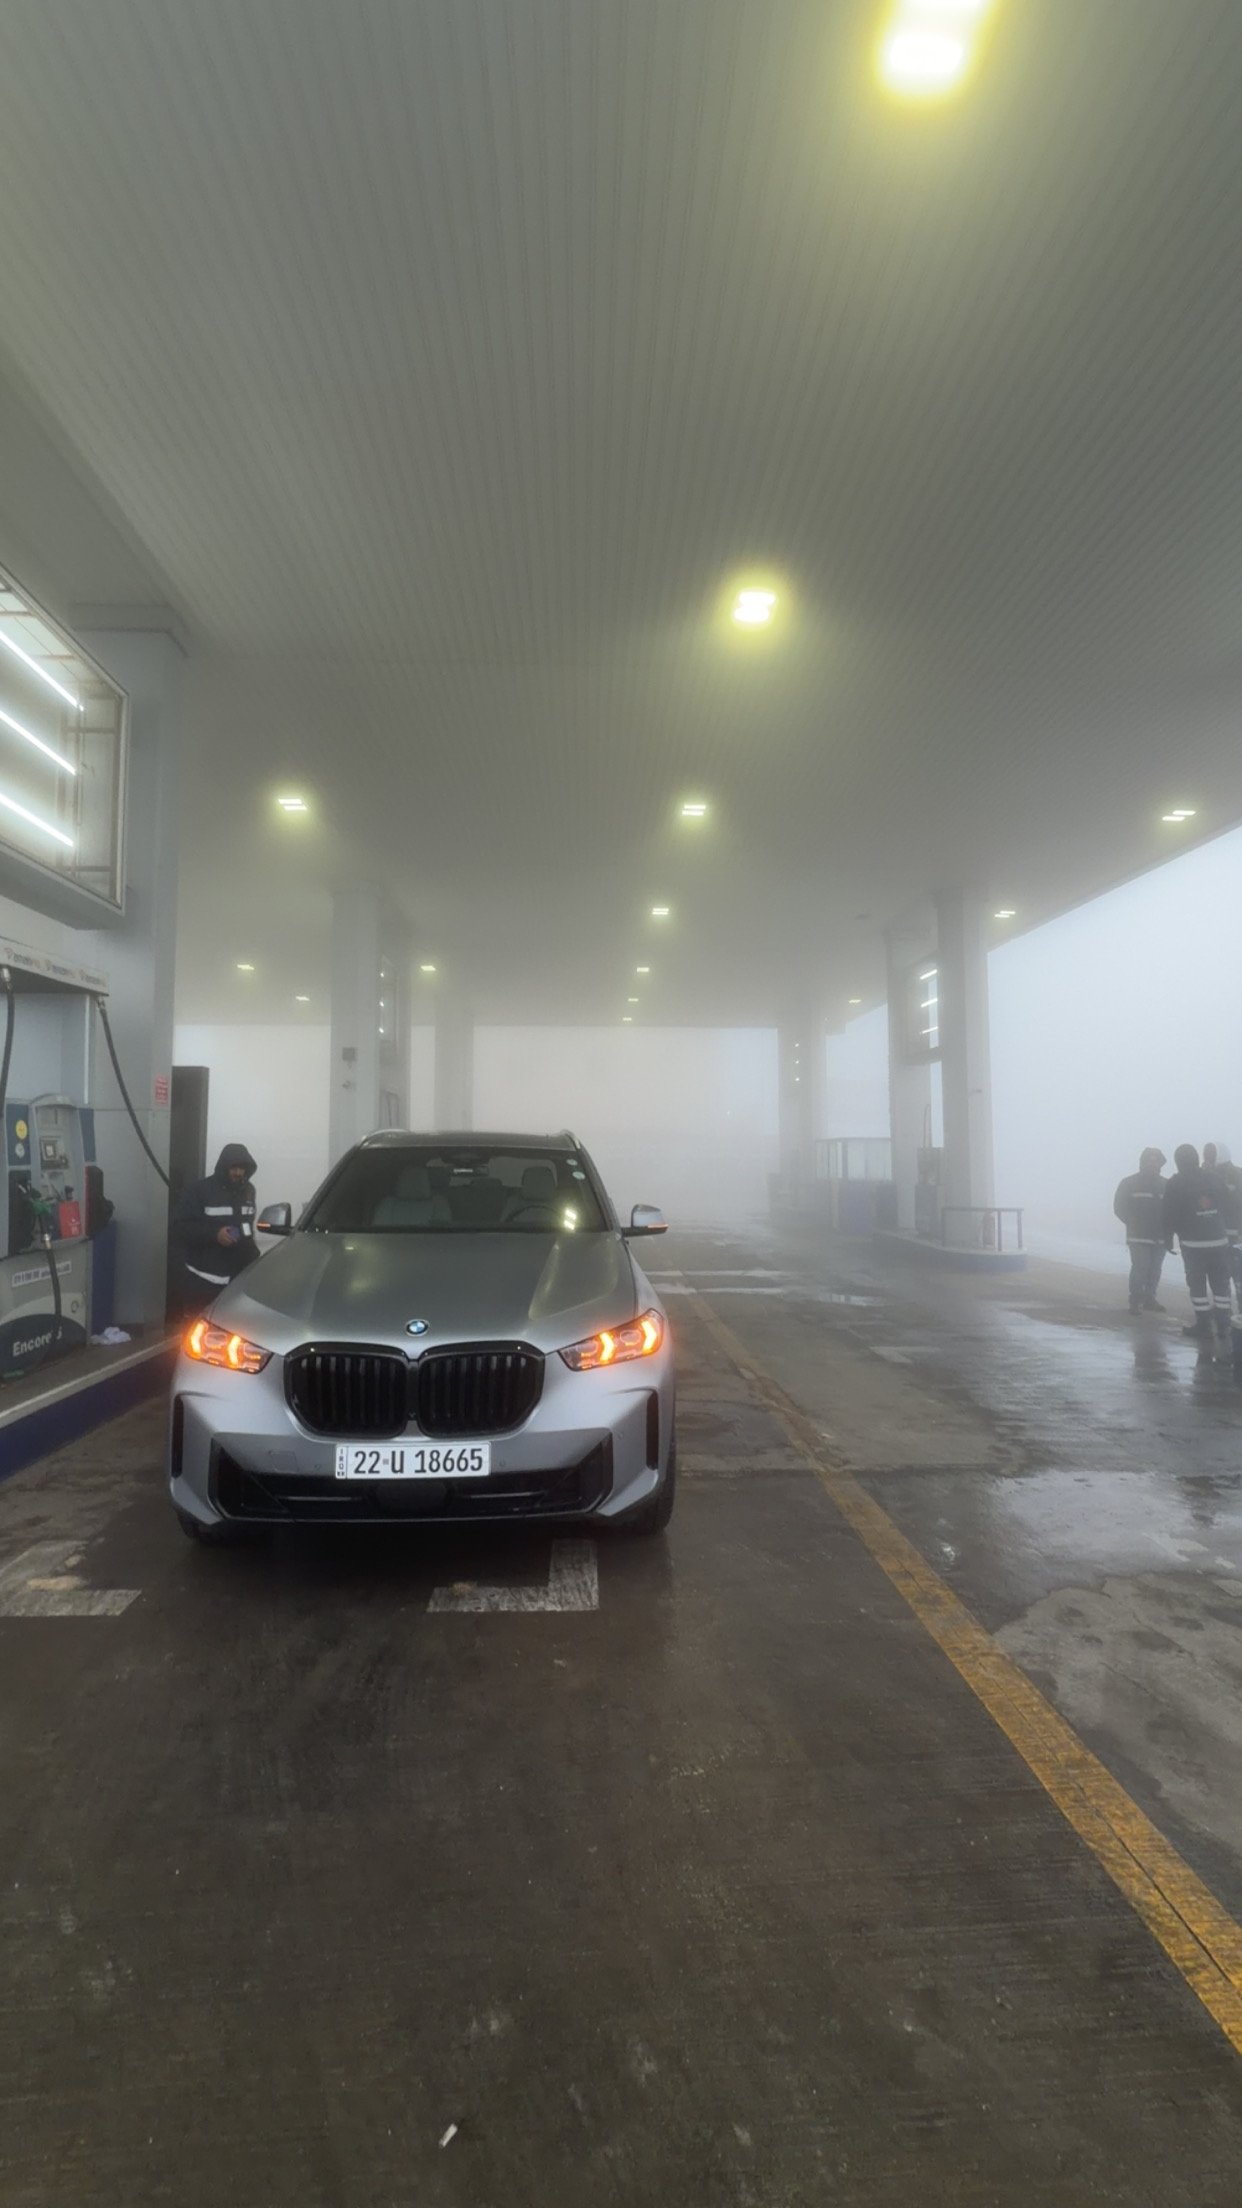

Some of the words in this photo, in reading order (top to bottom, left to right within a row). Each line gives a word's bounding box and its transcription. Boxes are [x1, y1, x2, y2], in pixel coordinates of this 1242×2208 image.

[12, 1331, 53, 1357] Encore
[354, 1450, 380, 1474] 22
[391, 1450, 404, 1474] U
[414, 1448, 483, 1473] 18665
